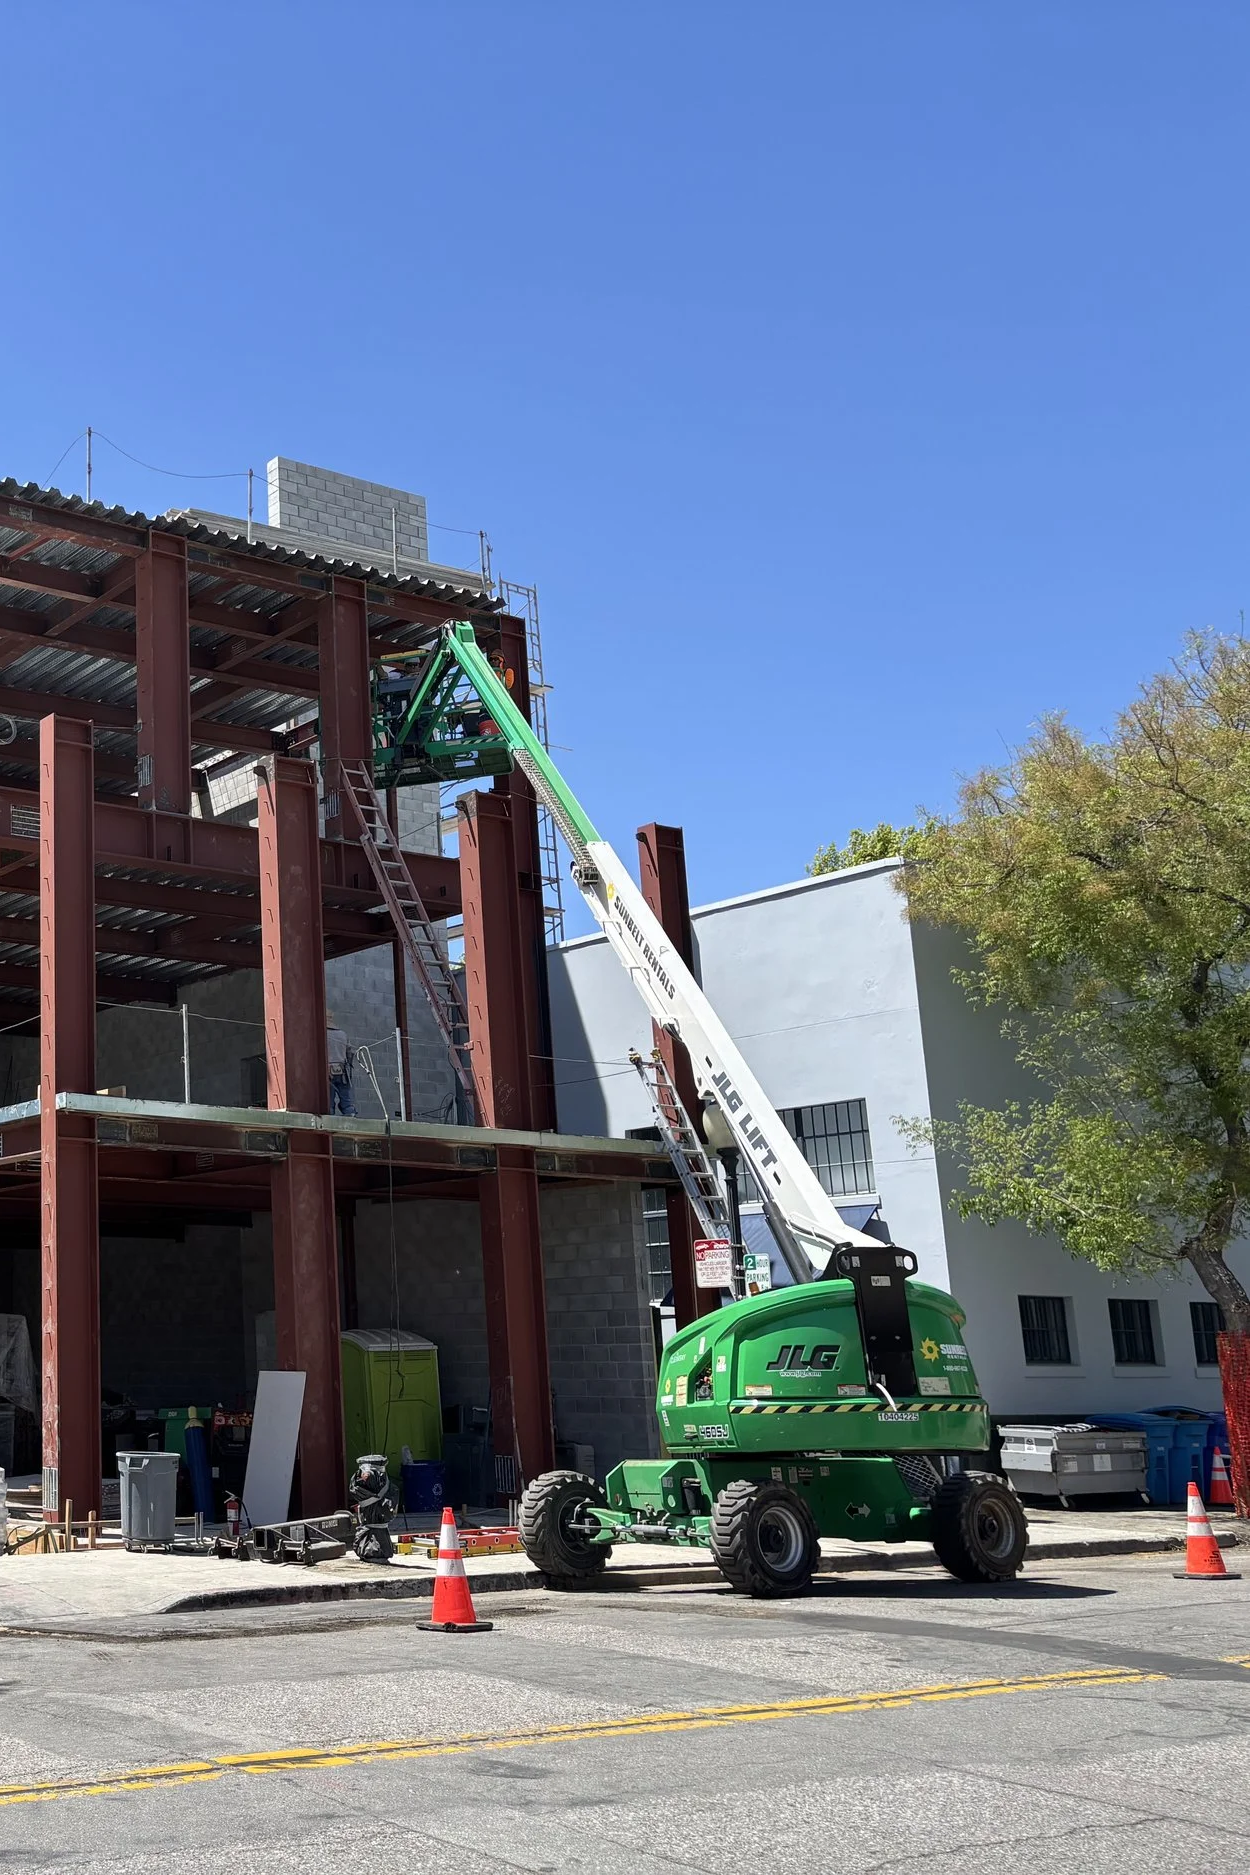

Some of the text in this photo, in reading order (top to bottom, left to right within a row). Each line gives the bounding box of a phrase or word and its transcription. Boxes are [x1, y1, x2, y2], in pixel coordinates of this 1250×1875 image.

[613, 895, 676, 1000] SUNBELT RENTALS
[711, 1071, 779, 1169] JLG LIFT
[696, 1250, 730, 1261] NO PARKING
[747, 1257, 754, 1269] 2
[746, 1272, 769, 1282] PARKING
[699, 1424, 729, 1440] 460SJ
